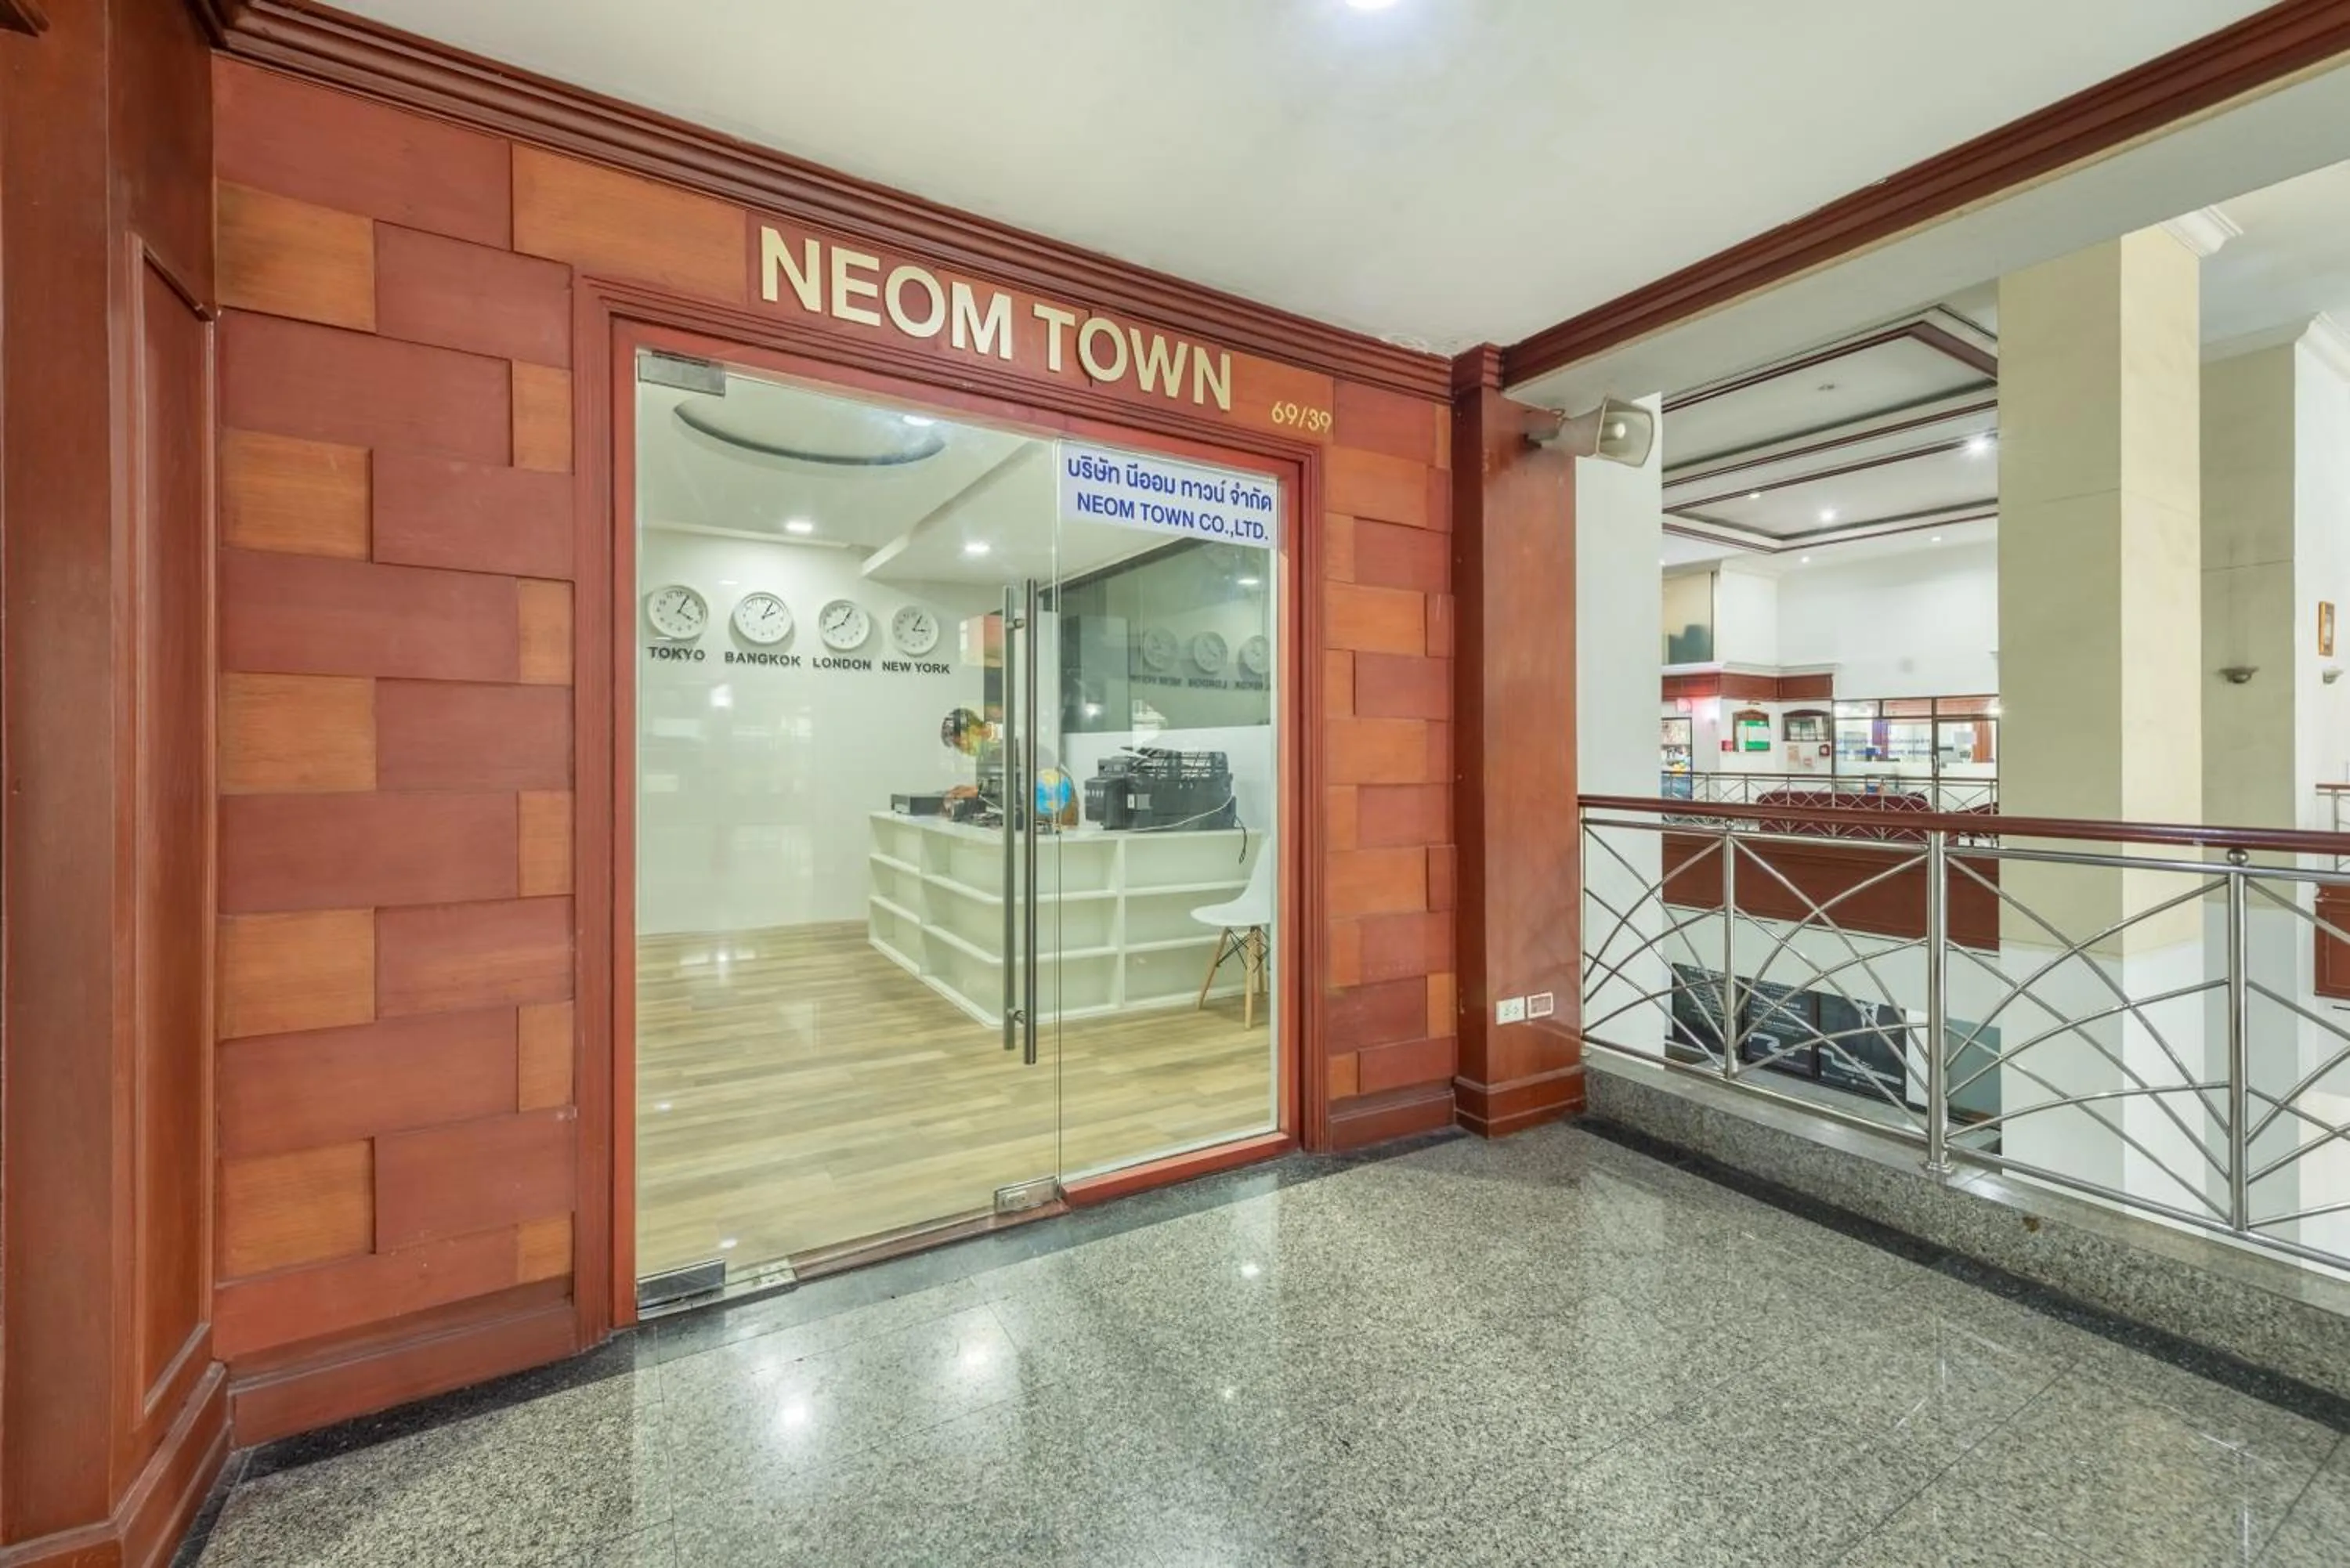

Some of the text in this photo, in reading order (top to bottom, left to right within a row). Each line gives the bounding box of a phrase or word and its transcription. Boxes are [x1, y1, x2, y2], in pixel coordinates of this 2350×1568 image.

[760, 226, 1231, 410] NEOM TOWN
[1271, 400, 1332, 433] 69/39
[1068, 455, 1272, 511] บริษัท นีออม ทาวน์ จำกัด
[1076, 491, 1269, 540] NEOM TOWN CO.,LTD.
[647, 646, 706, 661] TOKYO
[724, 651, 802, 667] BANGKOK
[812, 656, 872, 670] LONDON
[882, 661, 950, 674] NEW YORK
